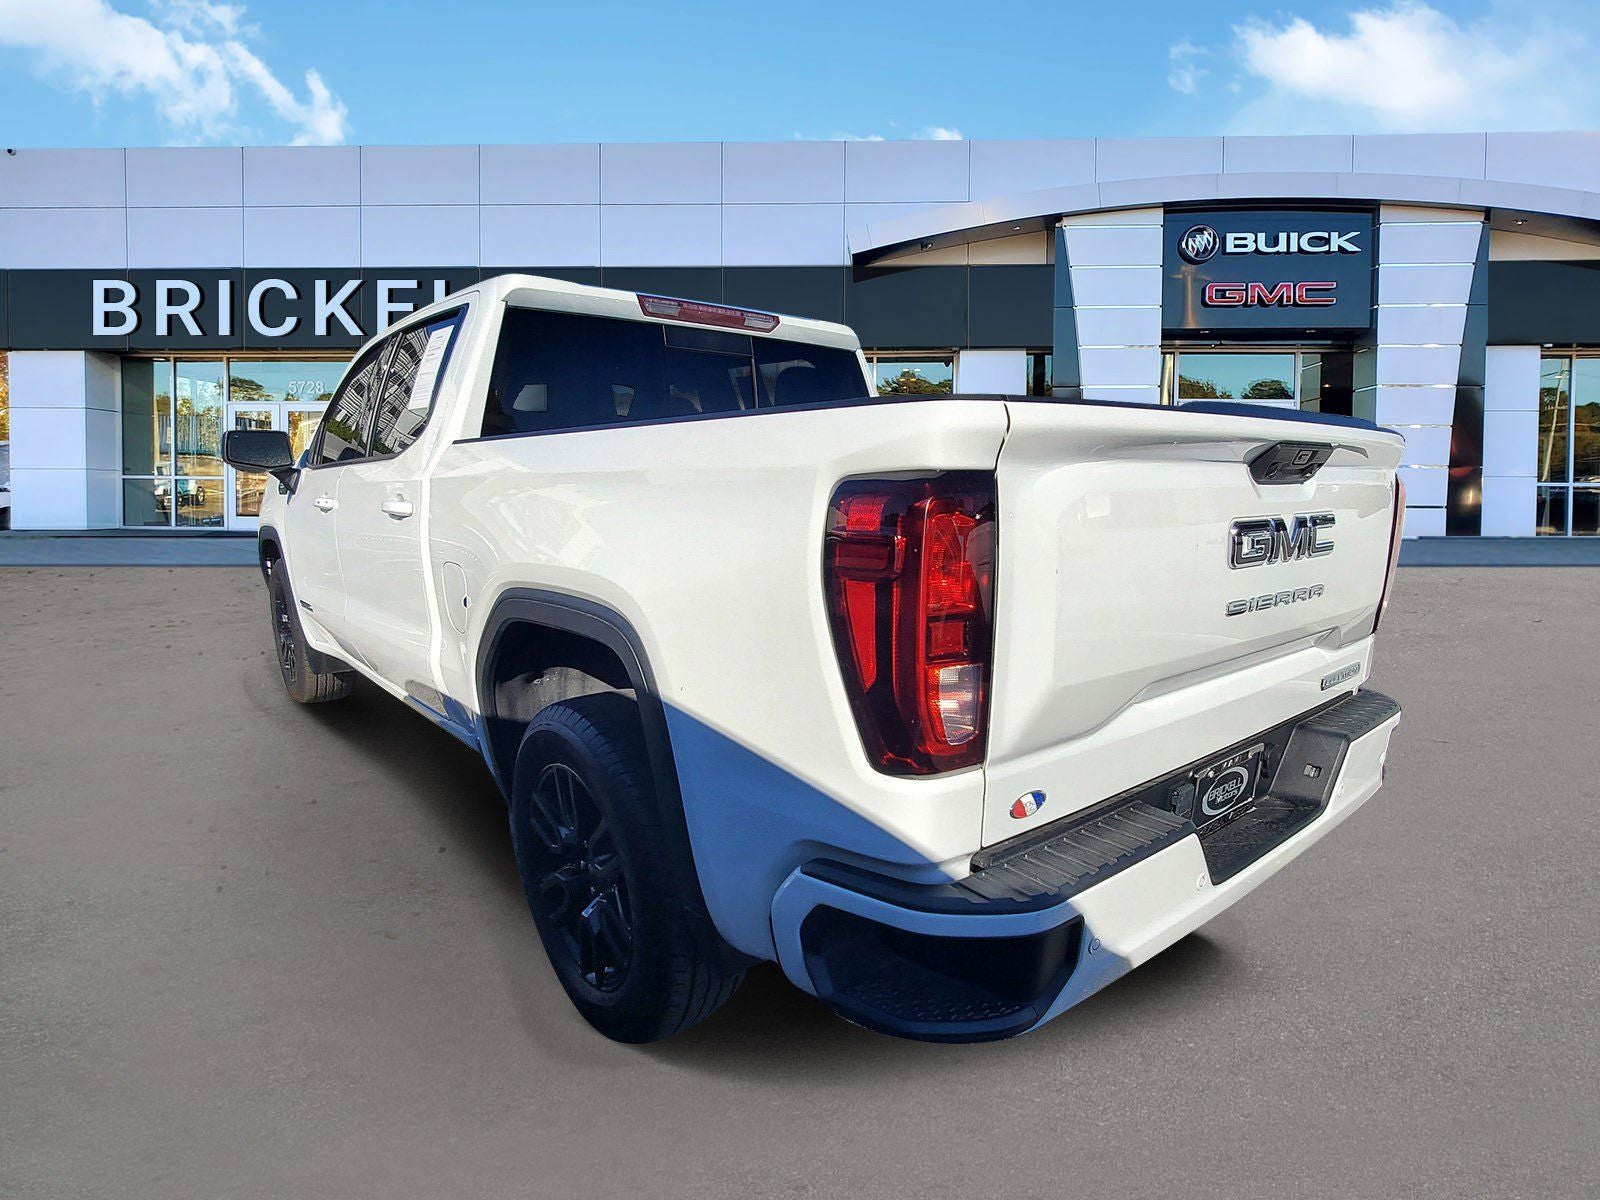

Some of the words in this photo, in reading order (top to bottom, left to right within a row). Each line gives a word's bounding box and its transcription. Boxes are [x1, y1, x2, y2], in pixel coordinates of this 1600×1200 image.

[1226, 231, 1361, 253] BUICK
[1205, 282, 1337, 305] GMC
[289, 380, 325, 394] 5728
[1227, 511, 1336, 569] GMC
[1225, 584, 1325, 617] SIERRA
